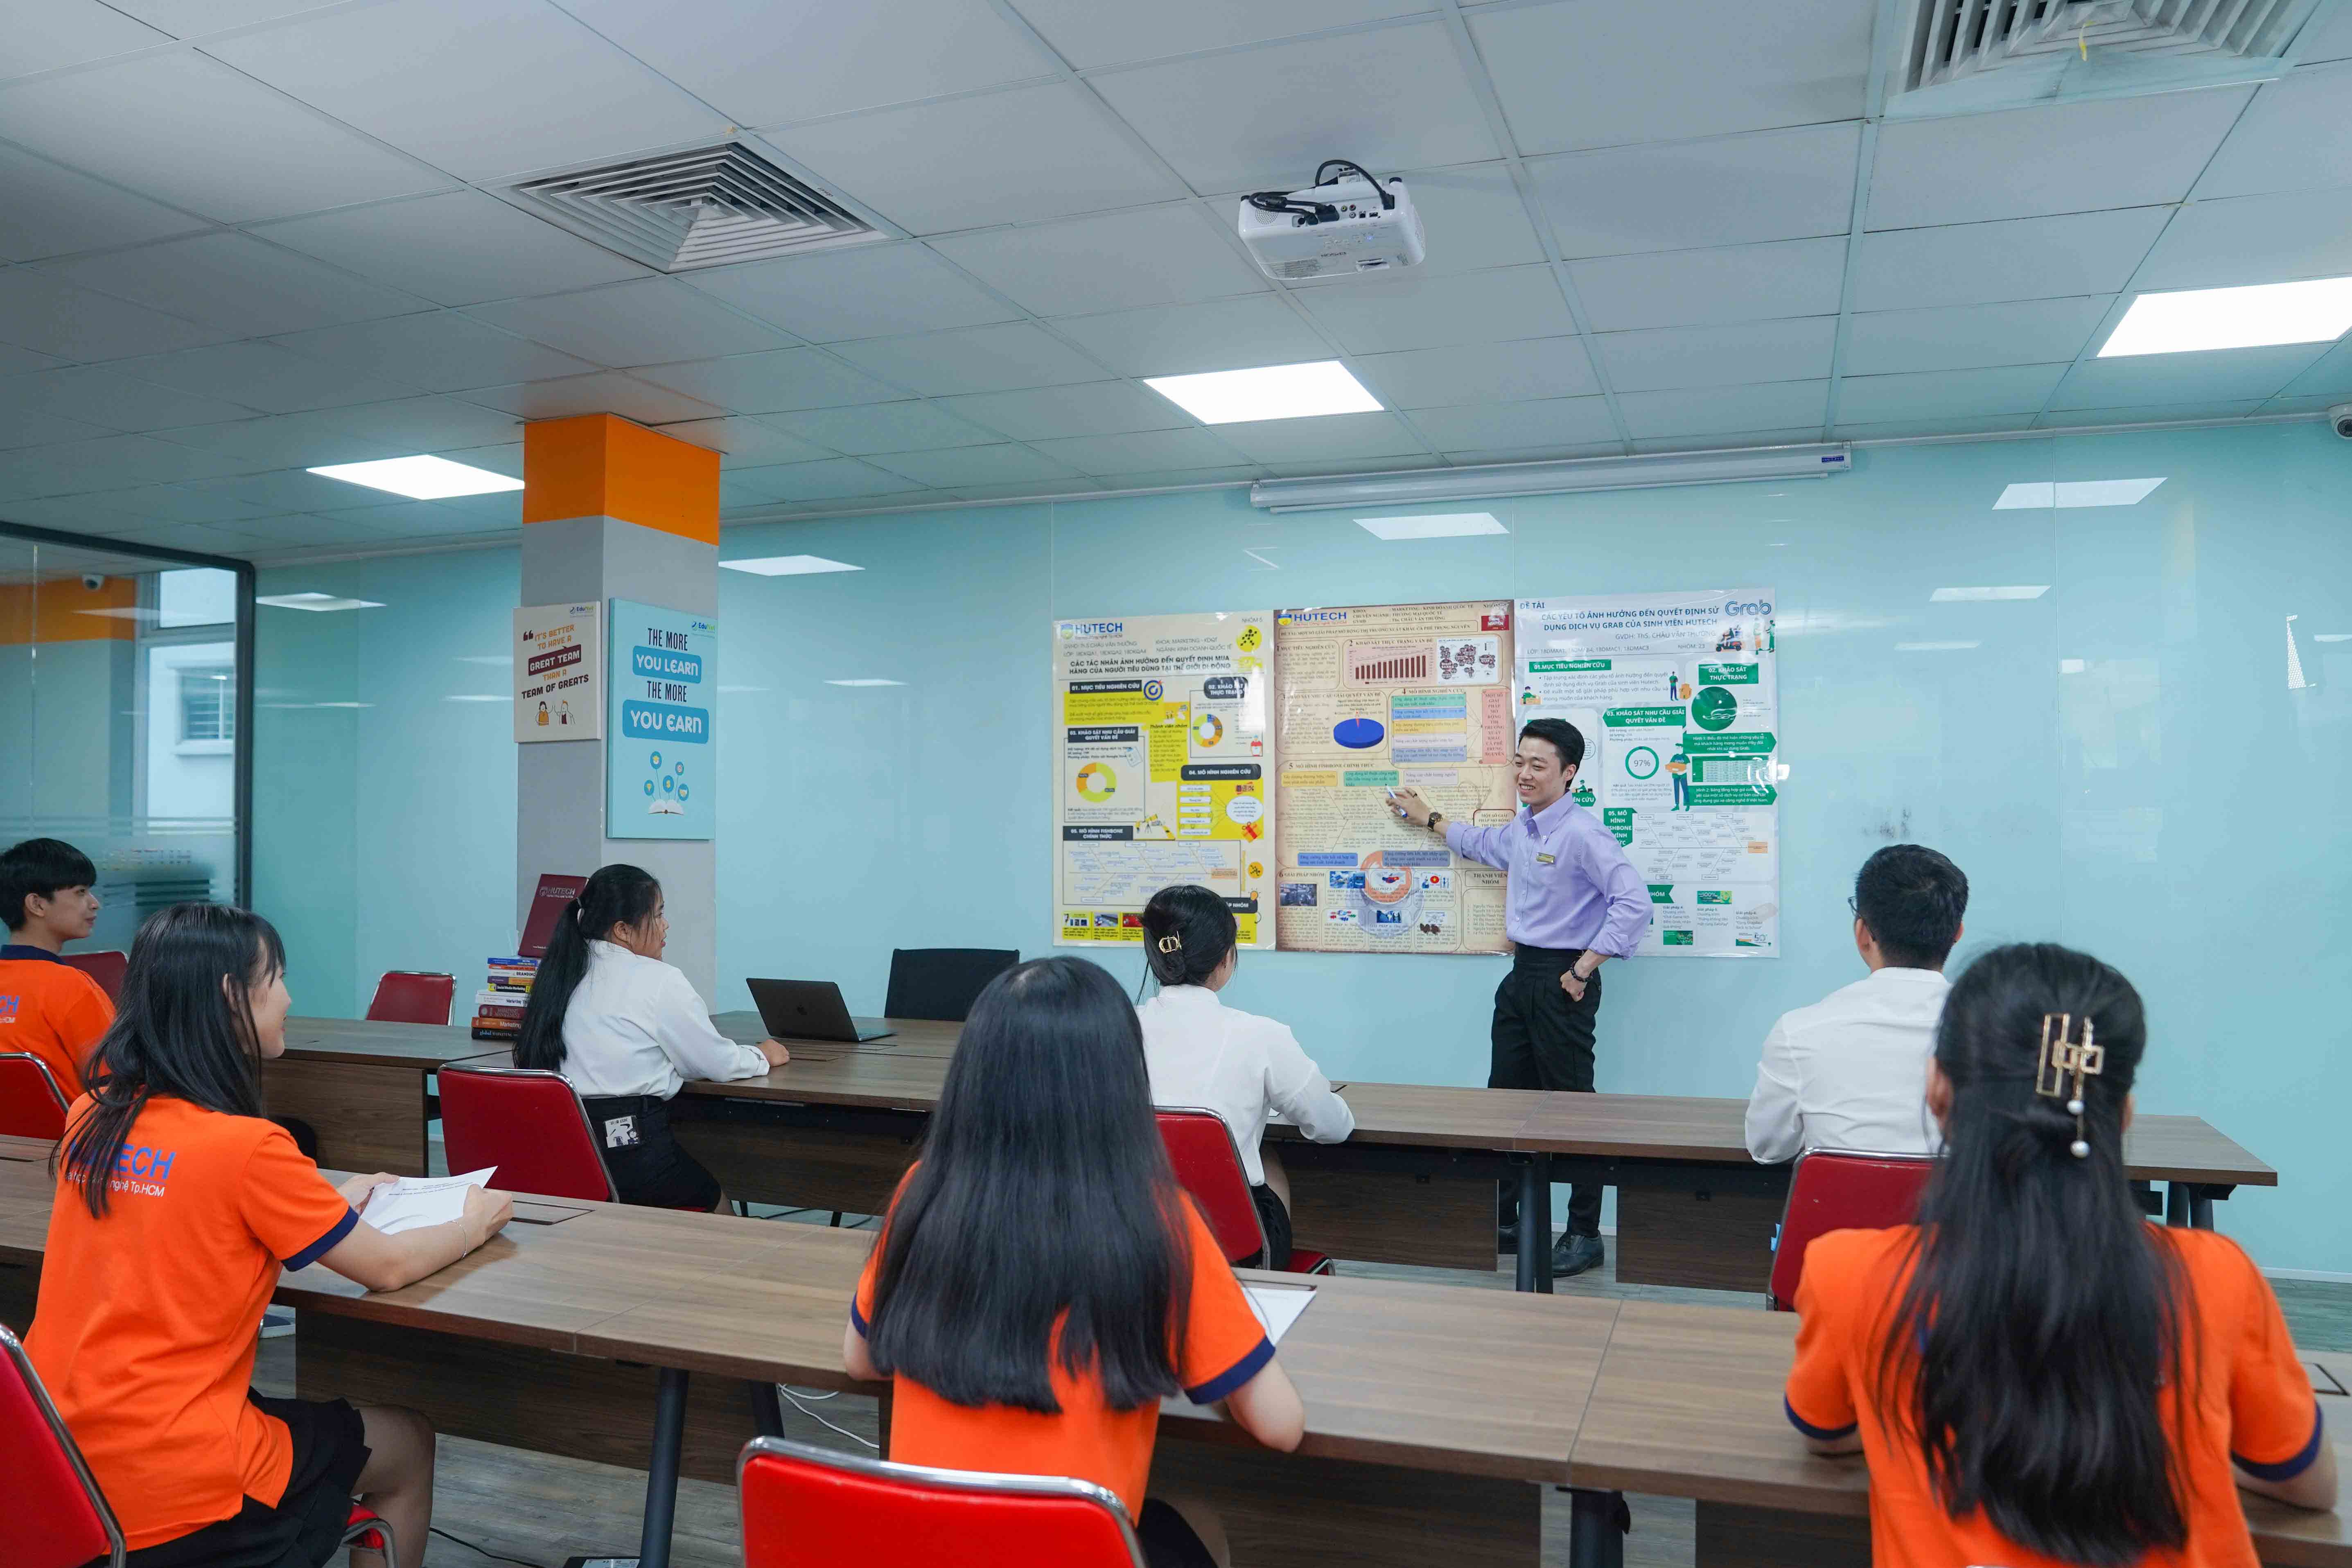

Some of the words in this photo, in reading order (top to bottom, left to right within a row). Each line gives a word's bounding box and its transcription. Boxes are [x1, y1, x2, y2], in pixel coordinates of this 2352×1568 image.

[1532, 601, 1545, 609] TÀI
[1725, 599, 1772, 616] Grab
[1294, 612, 1347, 622] HUTECH
[1587, 610, 1604, 618] ẢNH
[1606, 609, 1637, 618] HƯỞNG
[1639, 608, 1655, 617] ĐẾN
[1657, 607, 1683, 617] QUYẾT
[1685, 608, 1706, 616] ĐỊNH
[549, 624, 575, 637] BETTER
[1075, 623, 1122, 634] HUTECH
[1544, 624, 1566, 632] DỤNG
[1589, 622, 1600, 630] VỤ
[1625, 619, 1641, 628] CỦA
[548, 636, 565, 648] HAVE
[648, 627, 663, 647] THE
[666, 631, 688, 651] MORE
[530, 656, 555, 672] GREAT
[558, 650, 580, 663] TEAM
[636, 654, 662, 671] YOU
[543, 670, 560, 681] THAN
[521, 686, 543, 699] TEAM
[546, 683, 556, 693] OF
[558, 674, 589, 690] GREATS
[647, 680, 662, 699] THE
[665, 683, 687, 702] MORE
[630, 710, 662, 730] YOU
[549, 887, 576, 895] HUTECH
[131, 1181, 166, 1198] Tp.HCM
